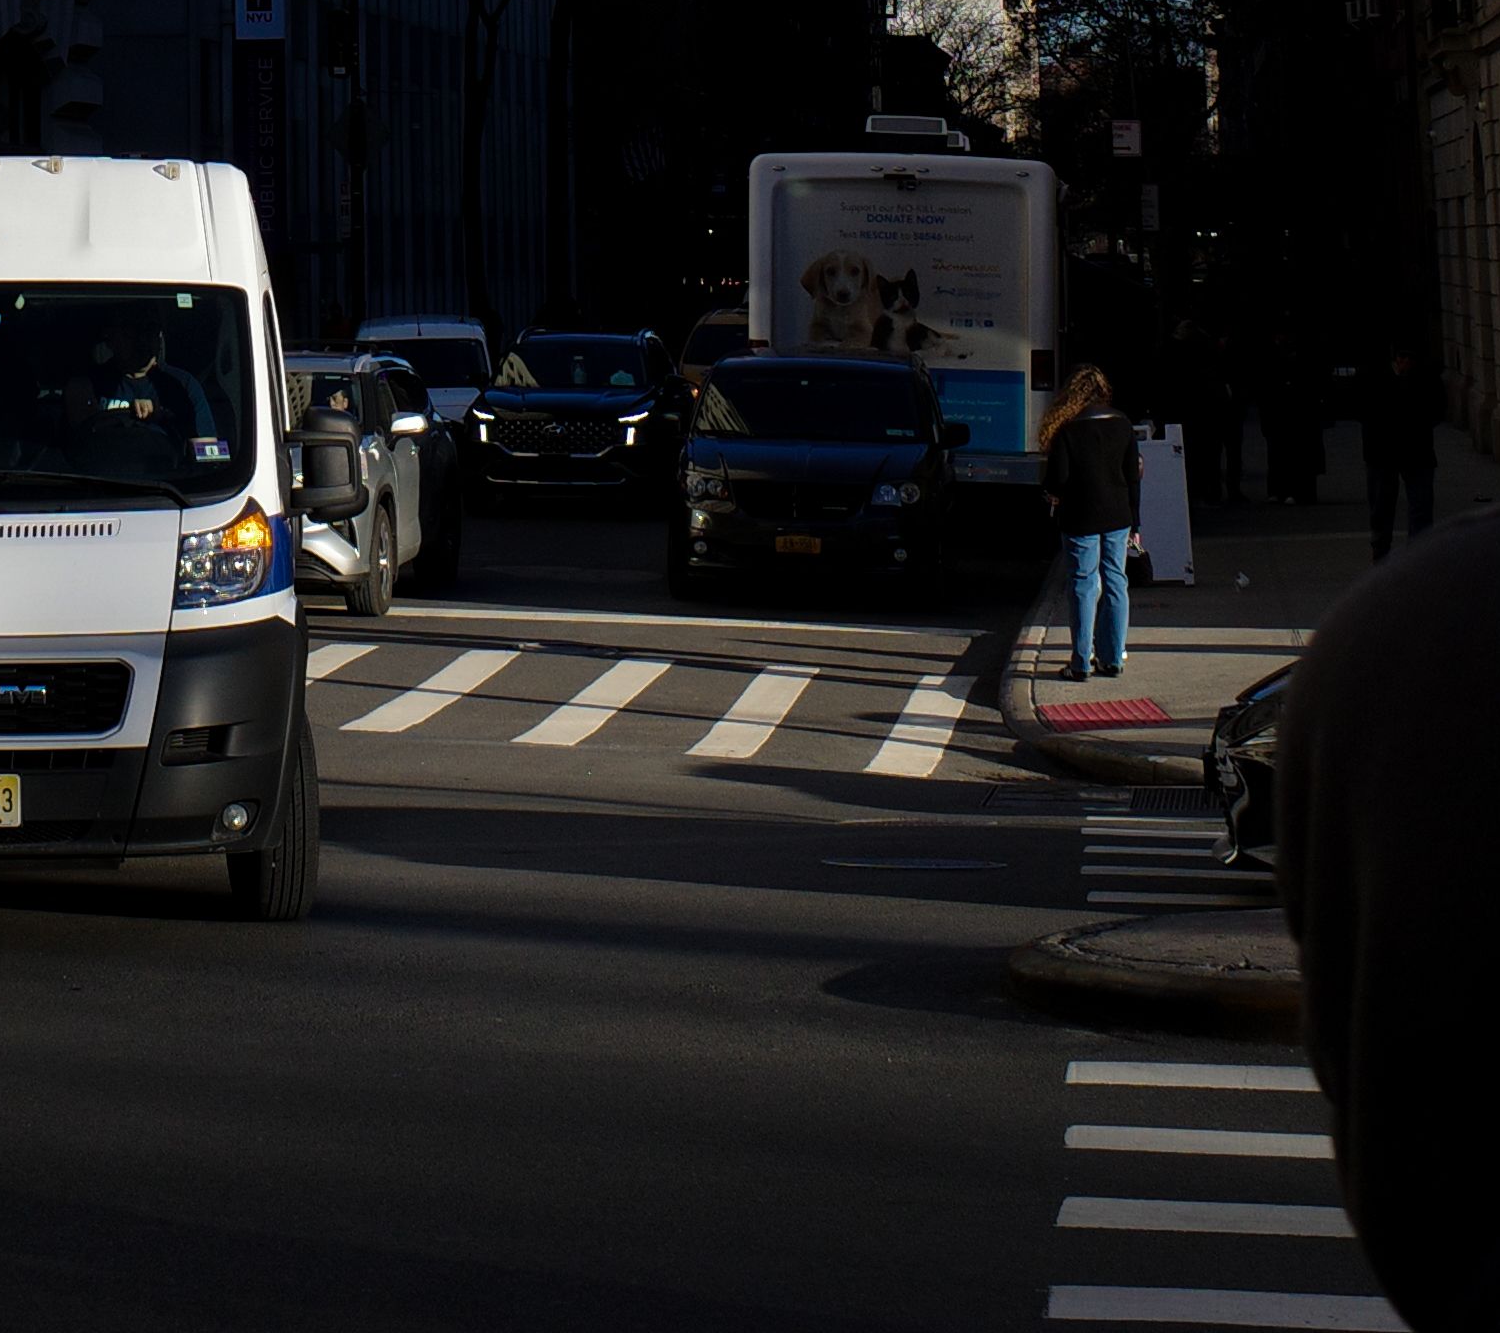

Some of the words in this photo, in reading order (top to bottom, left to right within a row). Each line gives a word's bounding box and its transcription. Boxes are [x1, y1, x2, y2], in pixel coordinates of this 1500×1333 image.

[246, 12, 272, 23] NYU
[258, 56, 274, 148] SERVICE
[259, 155, 275, 233] PUBLIC
[866, 213, 914, 224] DONATE
[916, 214, 946, 225] NOW
